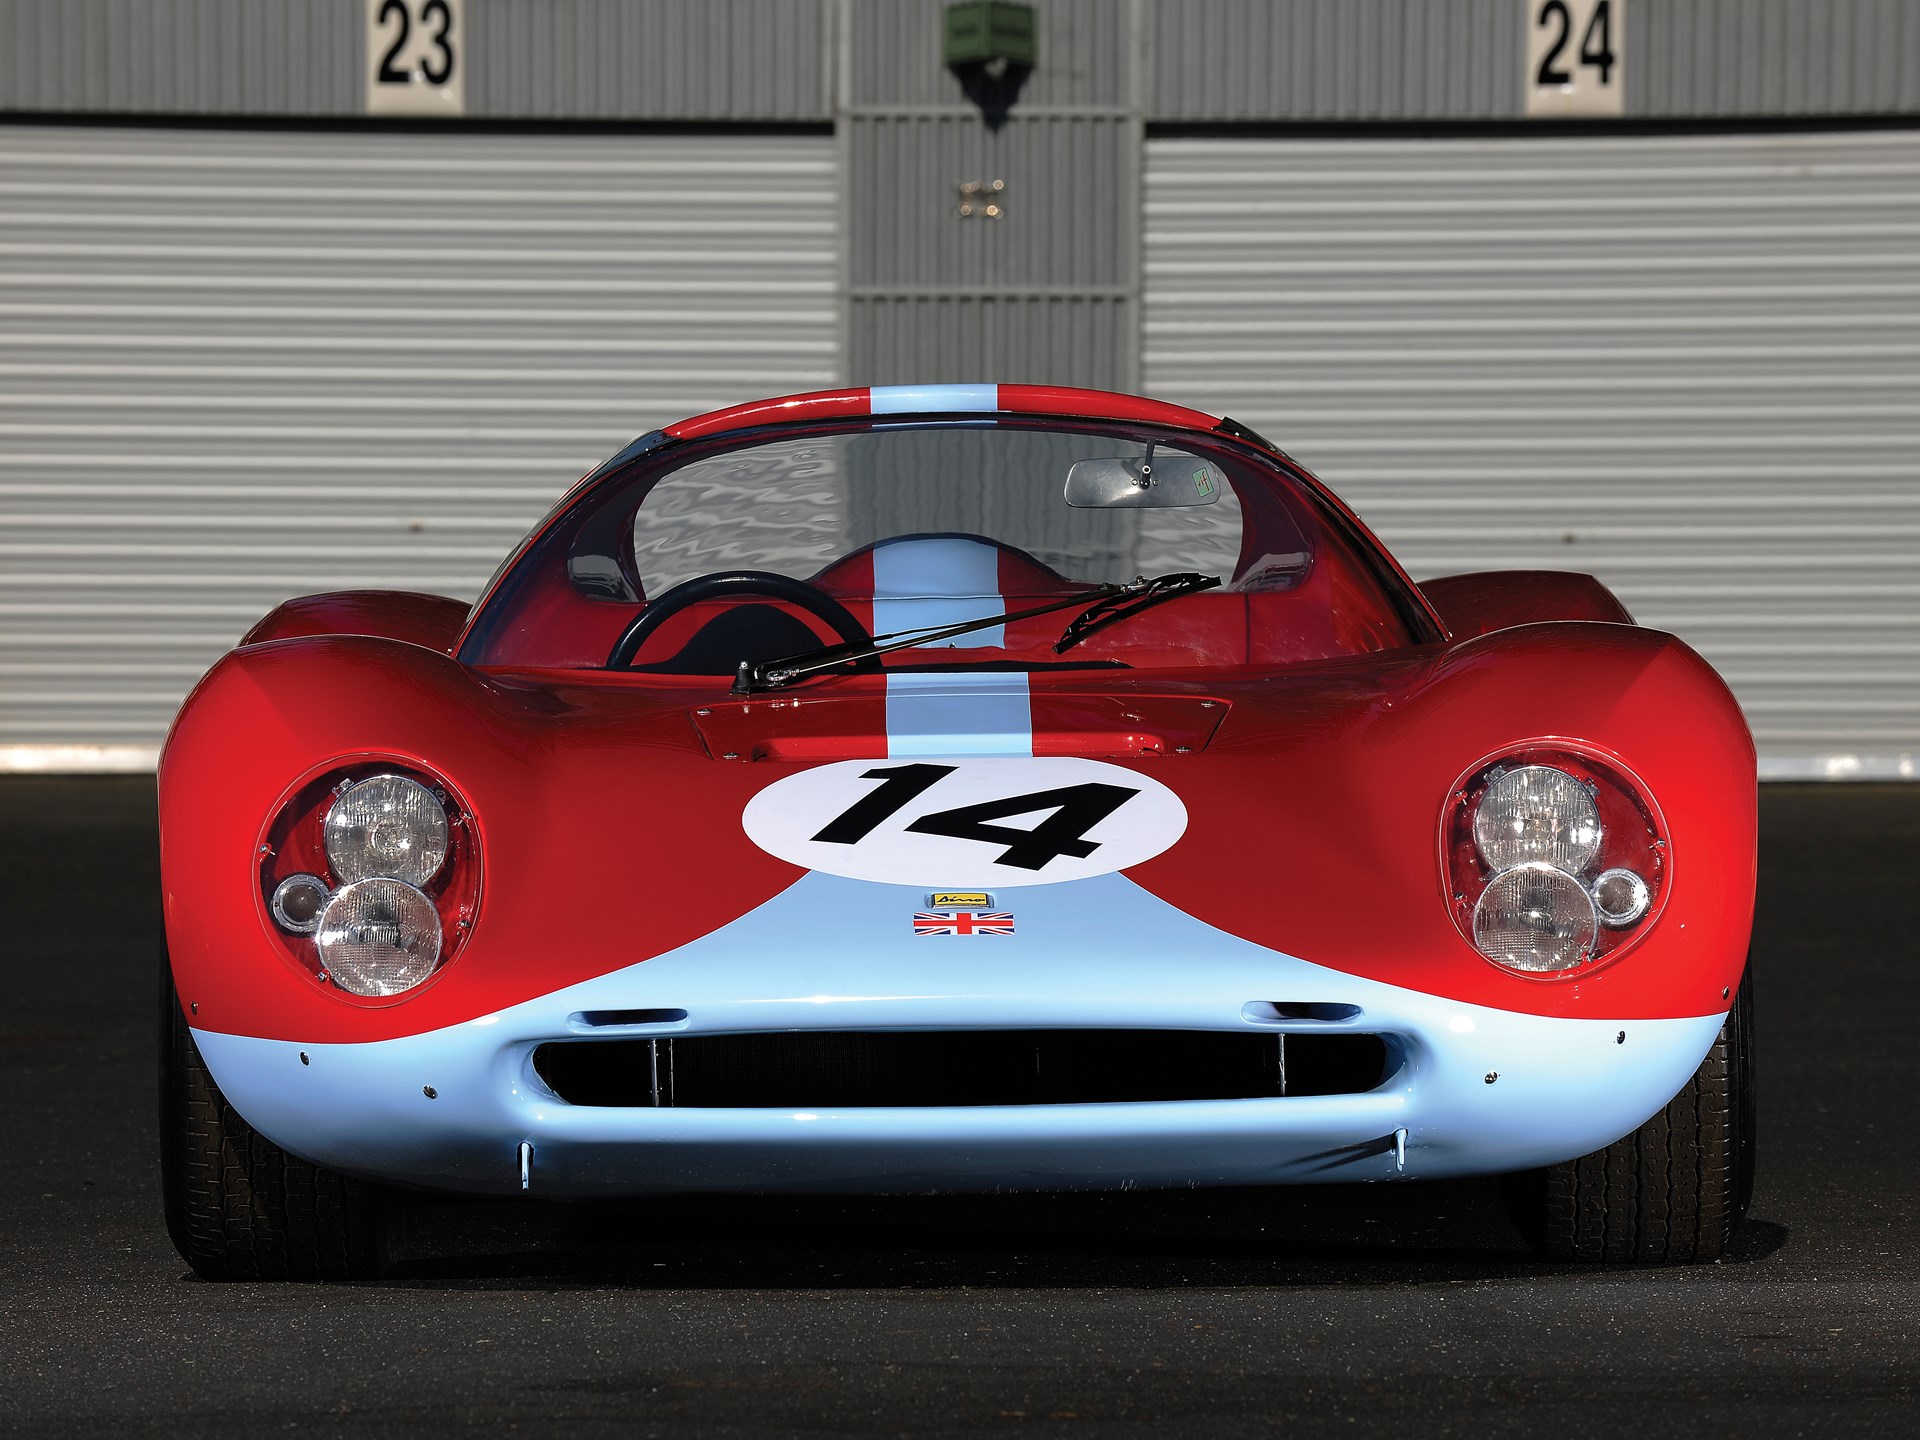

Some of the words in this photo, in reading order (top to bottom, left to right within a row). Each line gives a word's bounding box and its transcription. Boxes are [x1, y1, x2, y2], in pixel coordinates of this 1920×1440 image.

[378, 0, 453, 84] 23
[1537, 0, 1615, 84] 24
[808, 763, 1142, 871] 14
[936, 895, 986, 903] Dino
